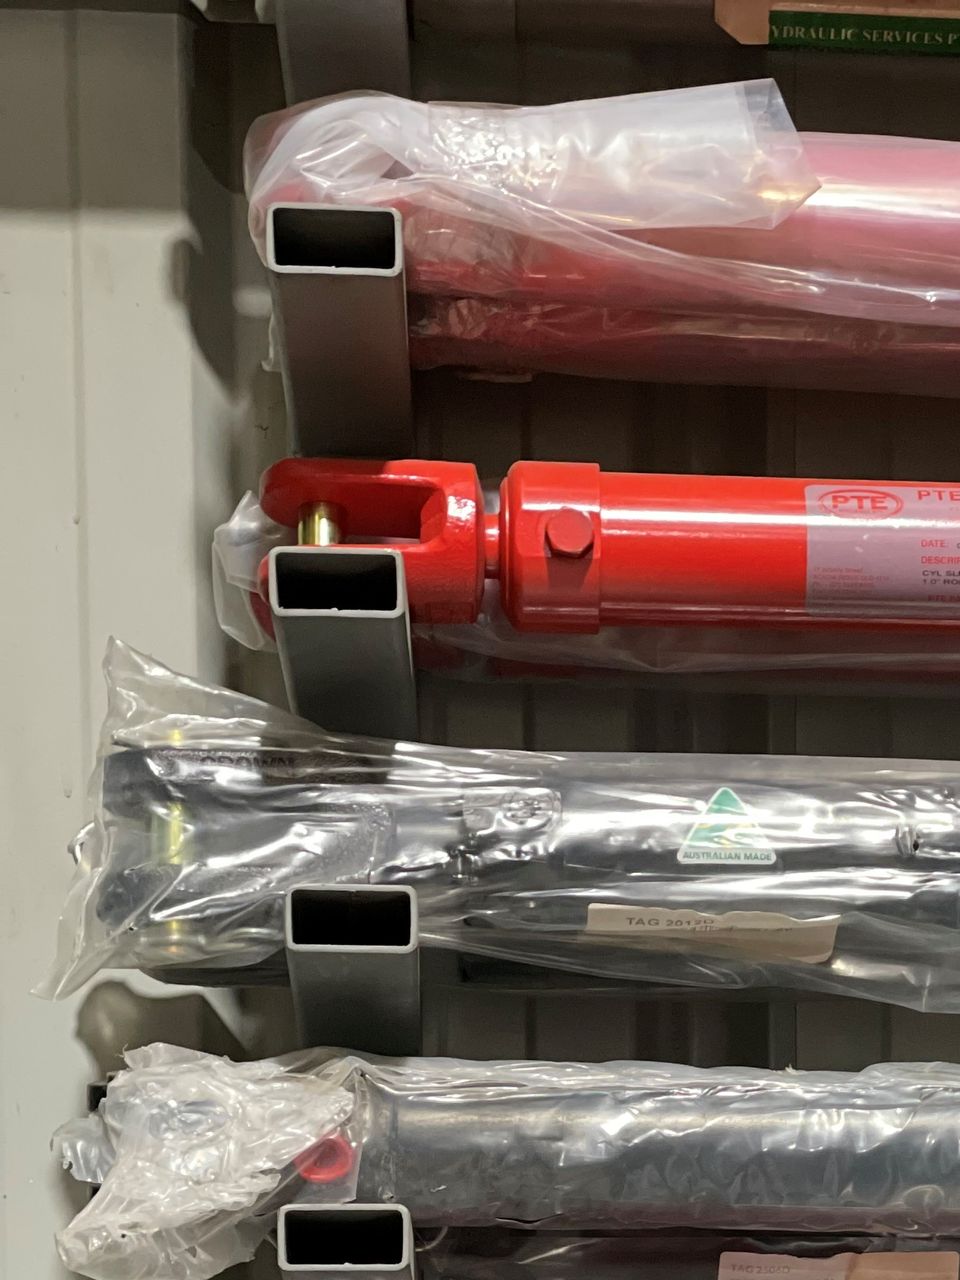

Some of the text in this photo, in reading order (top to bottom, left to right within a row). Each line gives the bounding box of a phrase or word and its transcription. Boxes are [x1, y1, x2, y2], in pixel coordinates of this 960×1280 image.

[862, 28, 943, 46] SERVICES
[831, 495, 888, 513] PTE
[922, 570, 941, 578] CYL
[682, 850, 773, 861] AUSTRALIAN MADE
[626, 917, 660, 927] TAG
